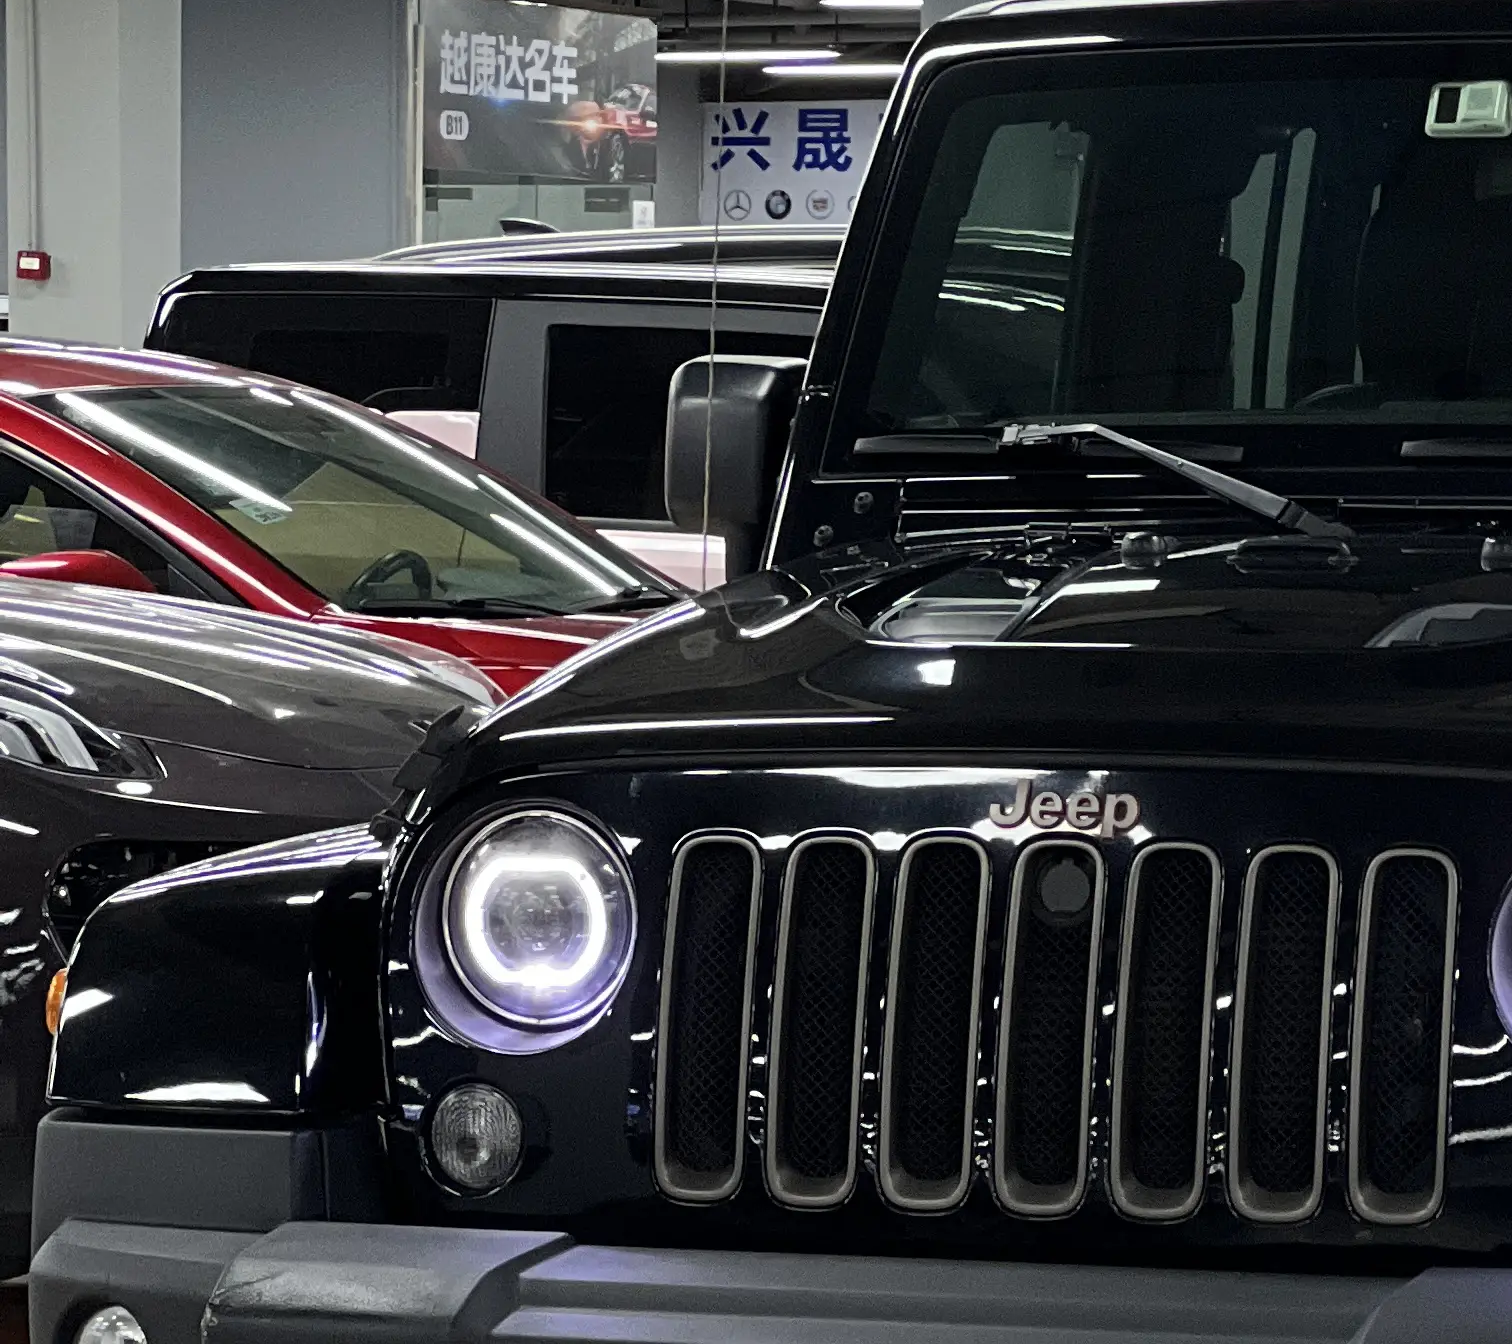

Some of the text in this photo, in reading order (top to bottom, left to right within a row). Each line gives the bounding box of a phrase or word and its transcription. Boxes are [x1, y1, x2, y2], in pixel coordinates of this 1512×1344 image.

[439, 29, 579, 105] 越康达名车
[445, 114, 463, 136] B11
[711, 107, 884, 172] 兴晟
[989, 778, 1141, 840] Jeep
